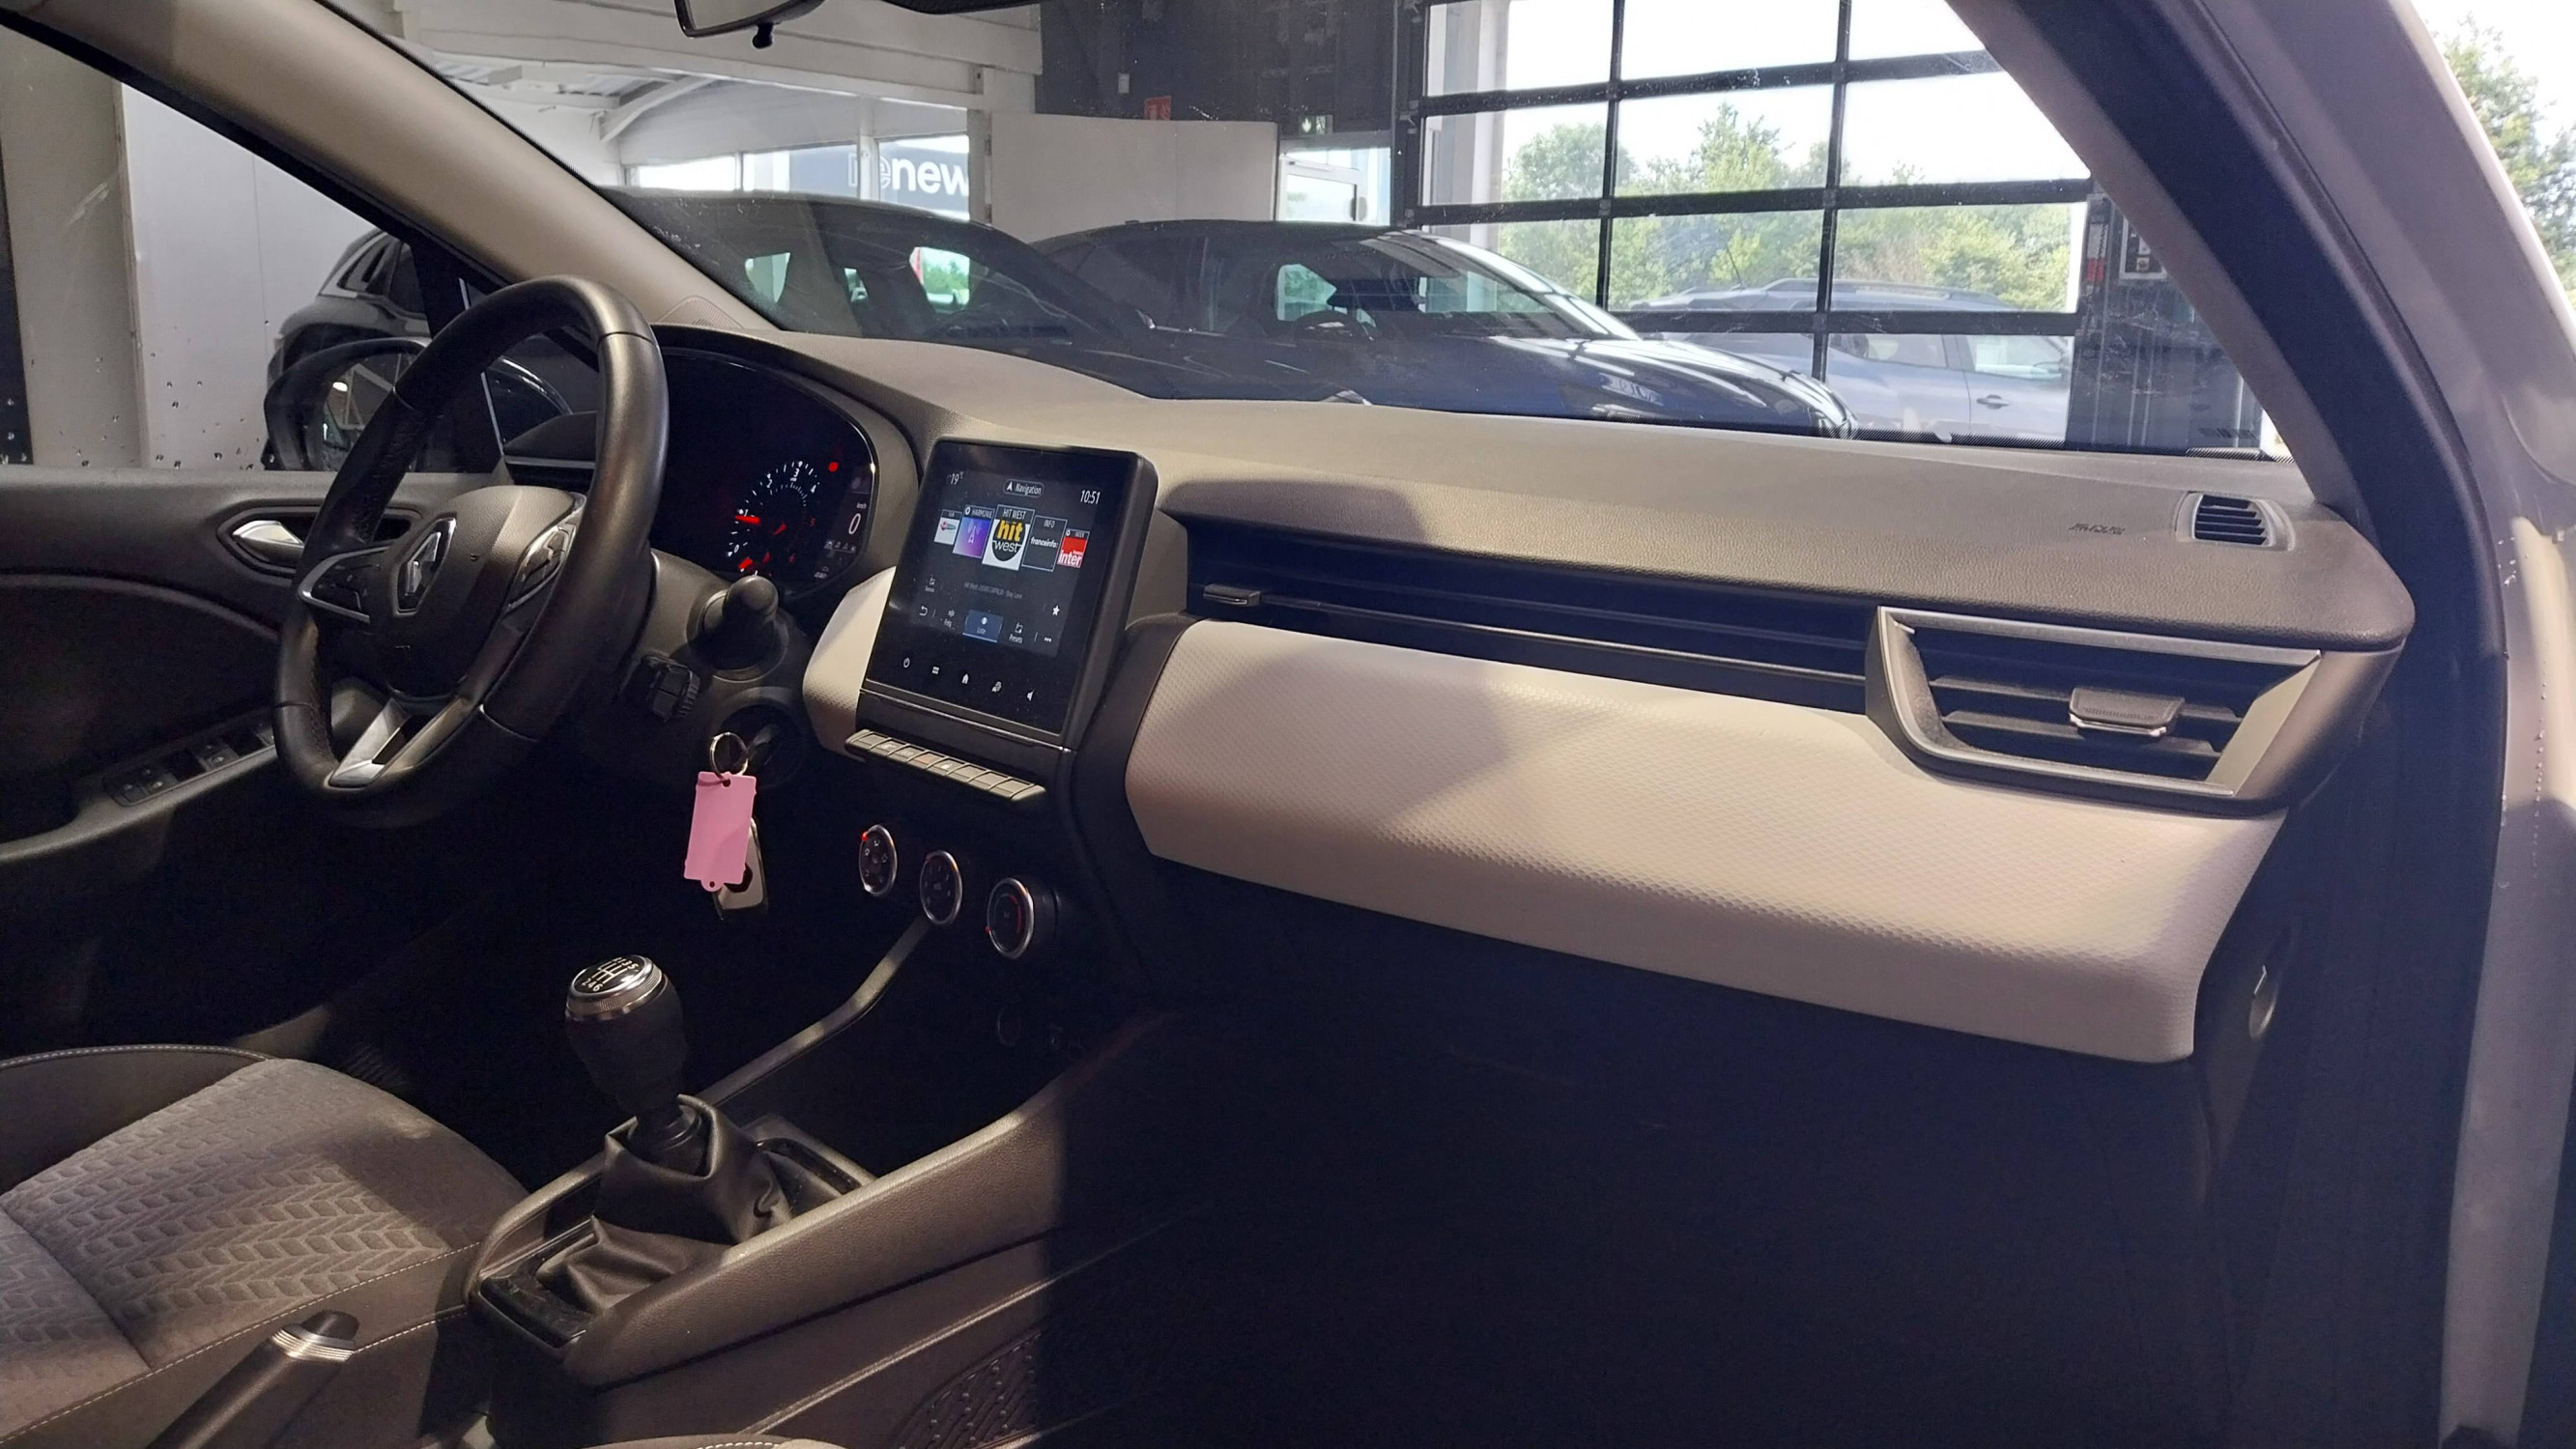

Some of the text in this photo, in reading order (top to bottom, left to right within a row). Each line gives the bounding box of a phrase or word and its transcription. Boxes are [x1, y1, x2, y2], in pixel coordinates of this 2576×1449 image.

[1015, 483, 1042, 496] Navigation
[1079, 490, 1101, 504] 10:51
[1012, 510, 1026, 521] WEST
[848, 510, 862, 535] 0
[997, 520, 1023, 541] hit
[994, 541, 1021, 553] west
